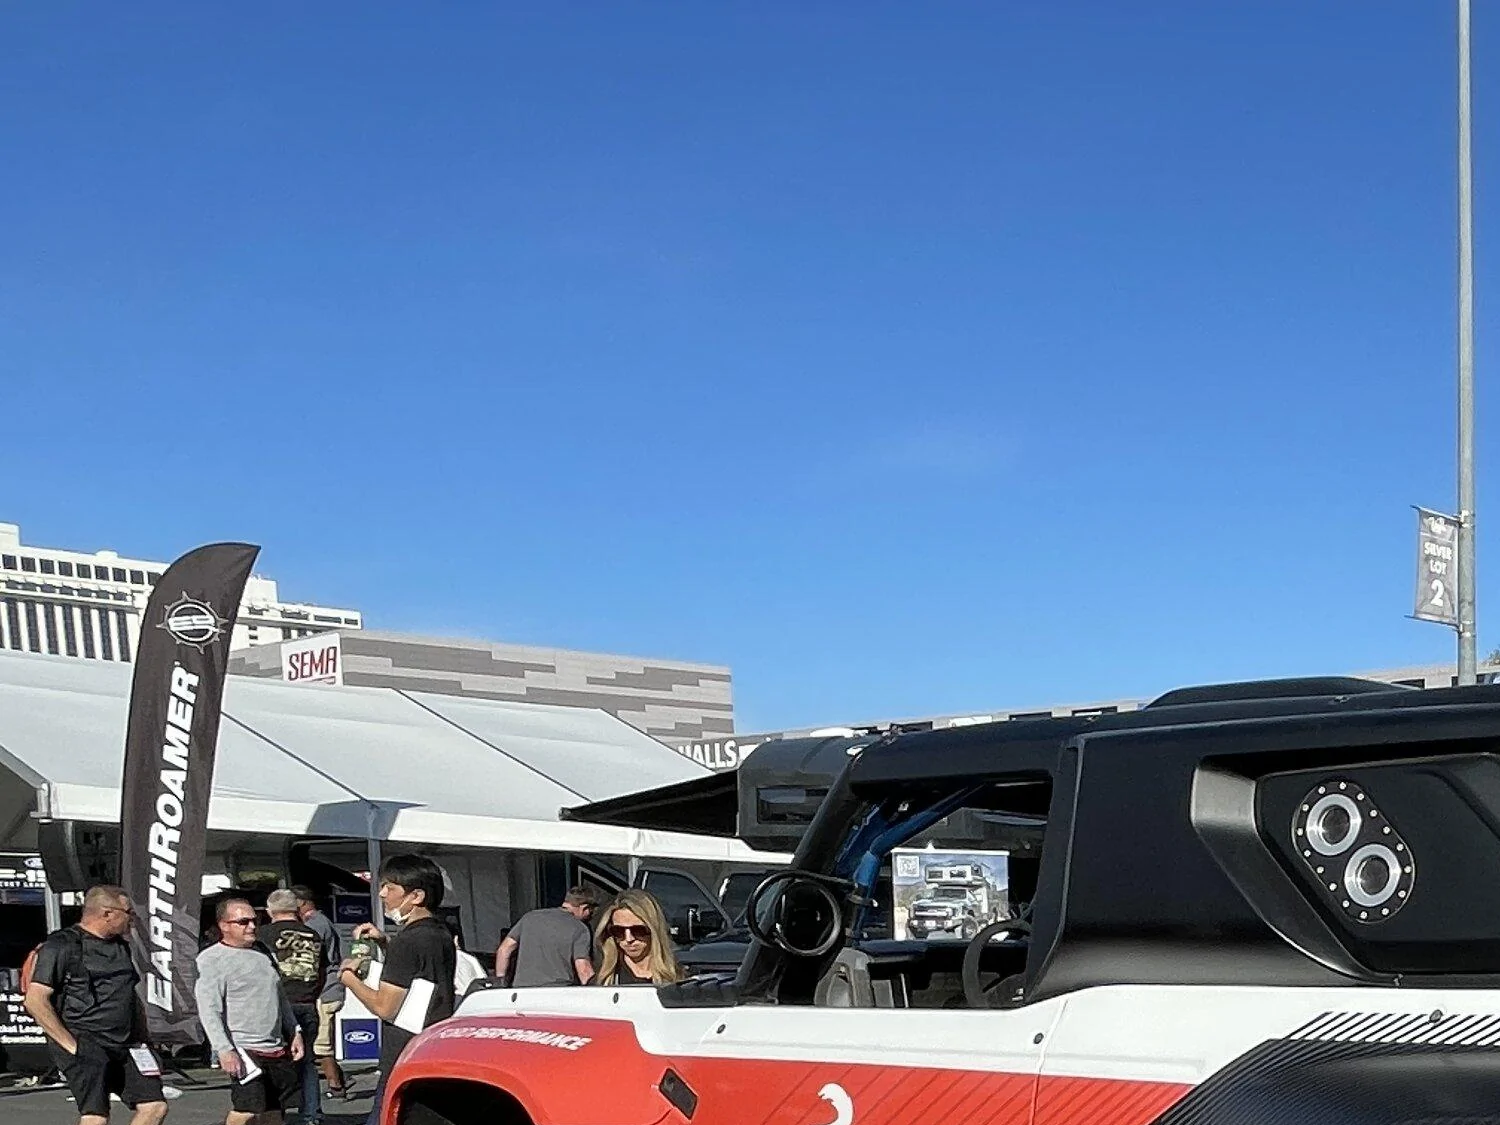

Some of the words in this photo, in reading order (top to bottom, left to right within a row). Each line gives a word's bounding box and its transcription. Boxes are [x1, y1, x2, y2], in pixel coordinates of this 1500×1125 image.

[1424, 542, 1453, 560] SILVER
[1429, 560, 1447, 575] LOT
[1430, 579, 1445, 606] 2
[288, 646, 337, 680] SEMA
[147, 666, 200, 1012] EARTHROAMER
